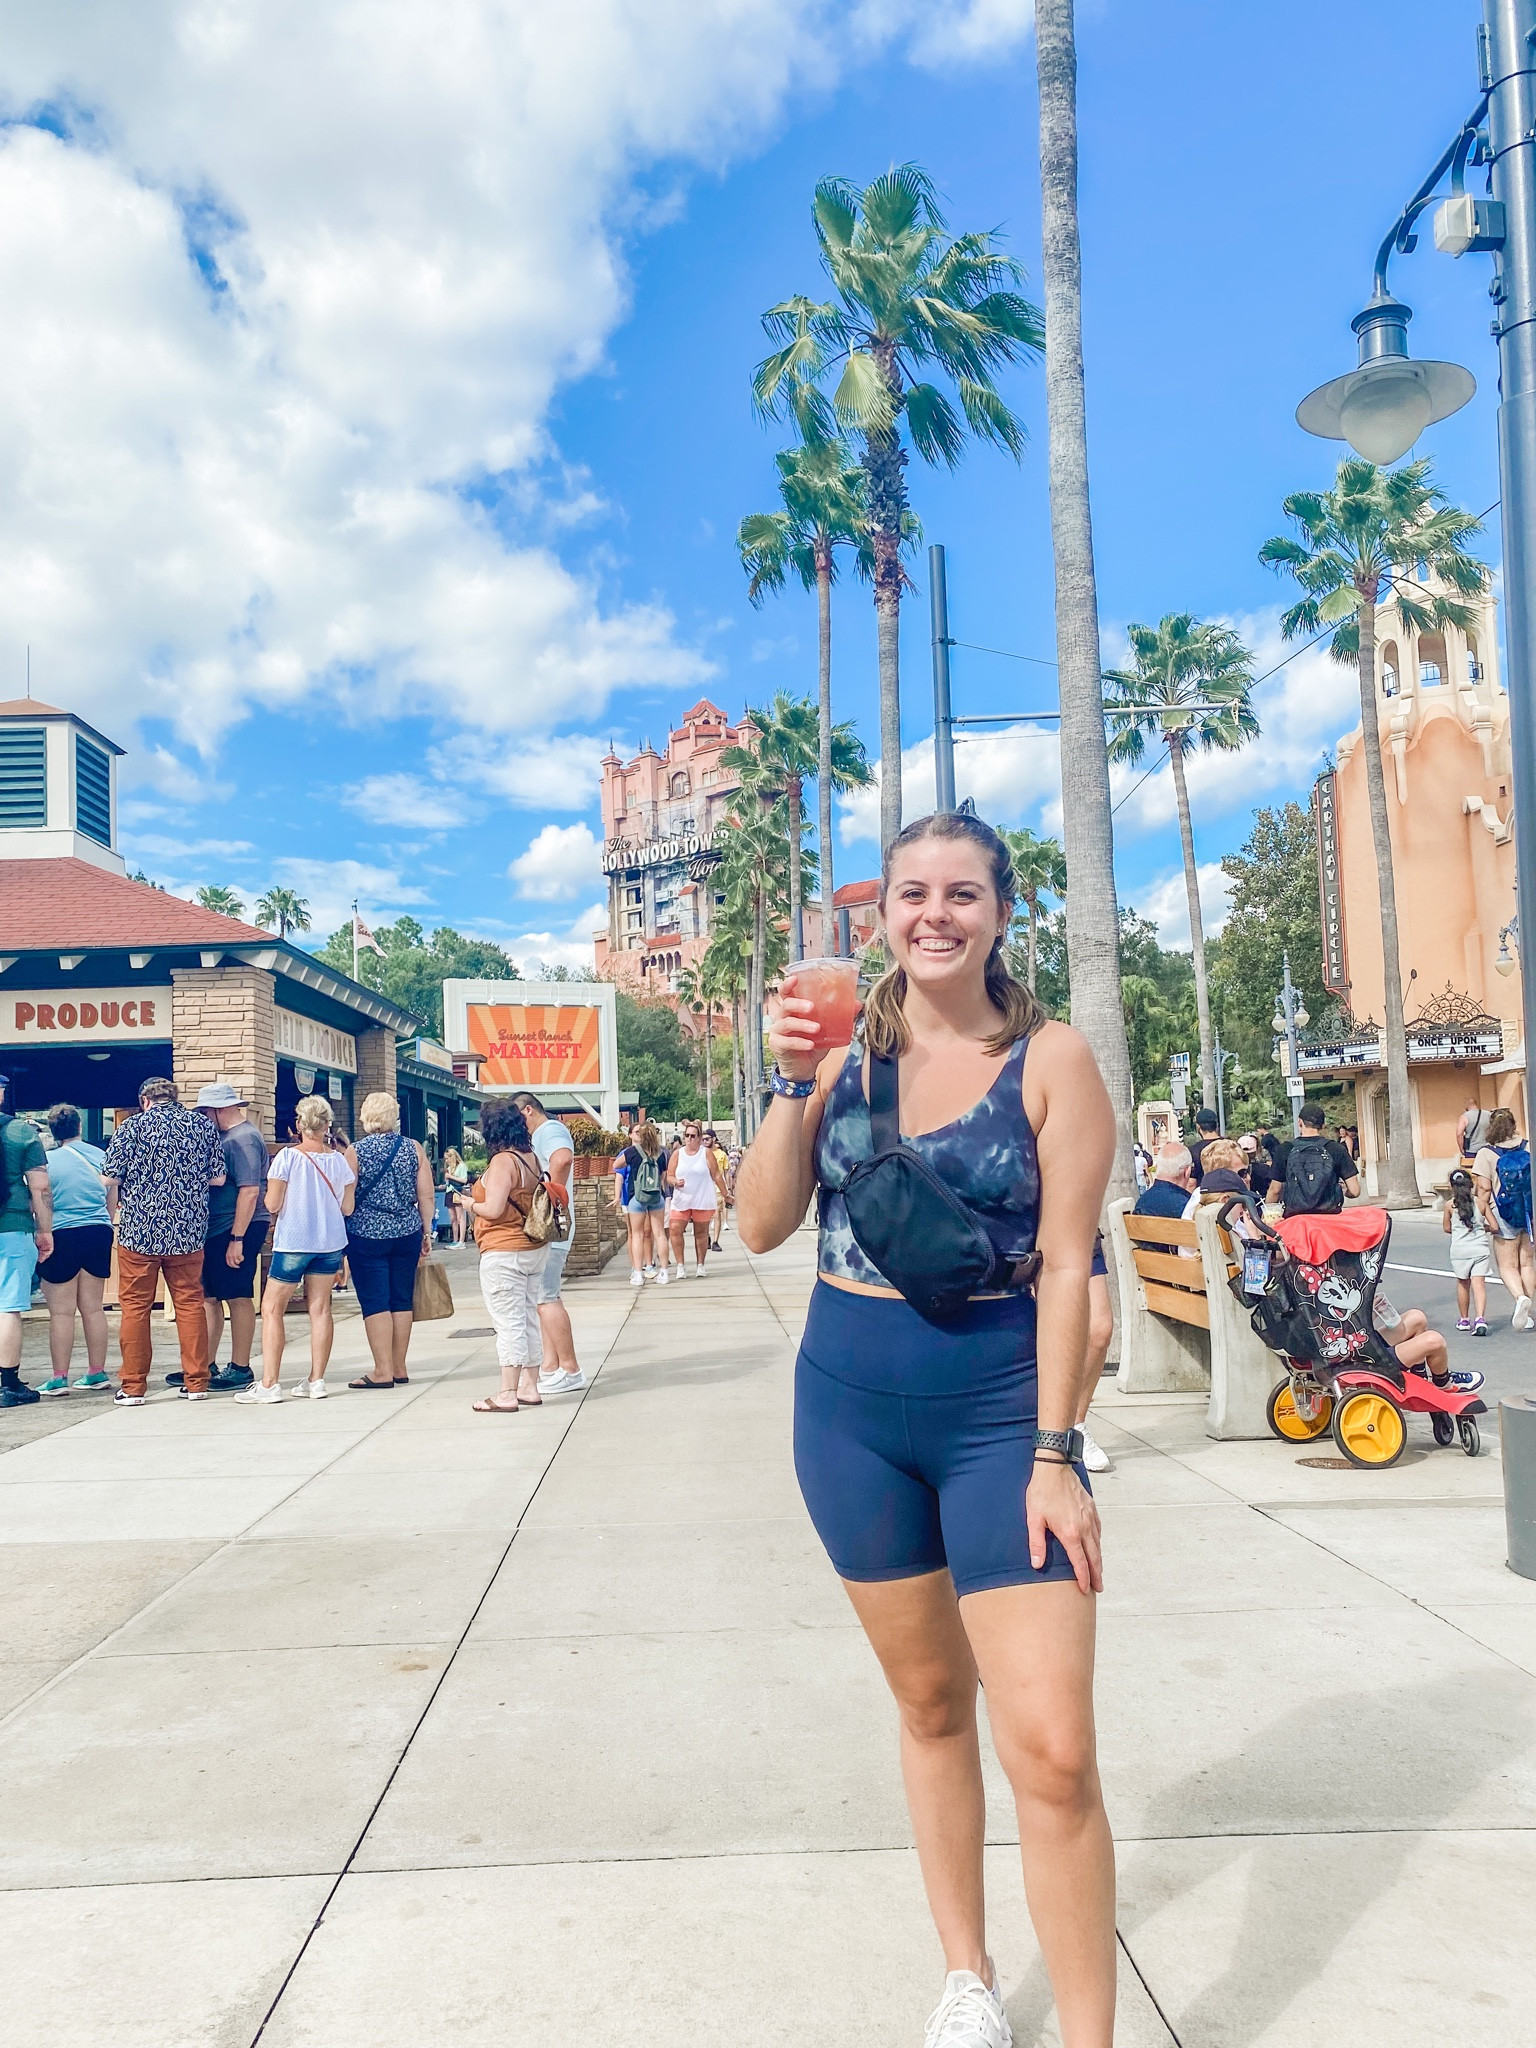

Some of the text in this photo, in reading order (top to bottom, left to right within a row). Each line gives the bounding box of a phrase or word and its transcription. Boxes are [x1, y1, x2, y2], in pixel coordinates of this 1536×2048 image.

[608, 835, 631, 852] The
[601, 840, 679, 872] HOLLYWOOD
[686, 858, 722, 877] Hote
[1321, 781, 1341, 979] CARTHAY CIRCLE
[15, 1001, 155, 1030] PRODUCE
[274, 1010, 304, 1053] HEIM
[498, 1028, 573, 1041] Sunset Ranch
[1417, 1036, 1477, 1047] ONCE UPON
[1449, 1045, 1487, 1054] A TIME
[489, 1043, 582, 1058] MARKET
[1304, 1047, 1344, 1058] ONCE UPON
